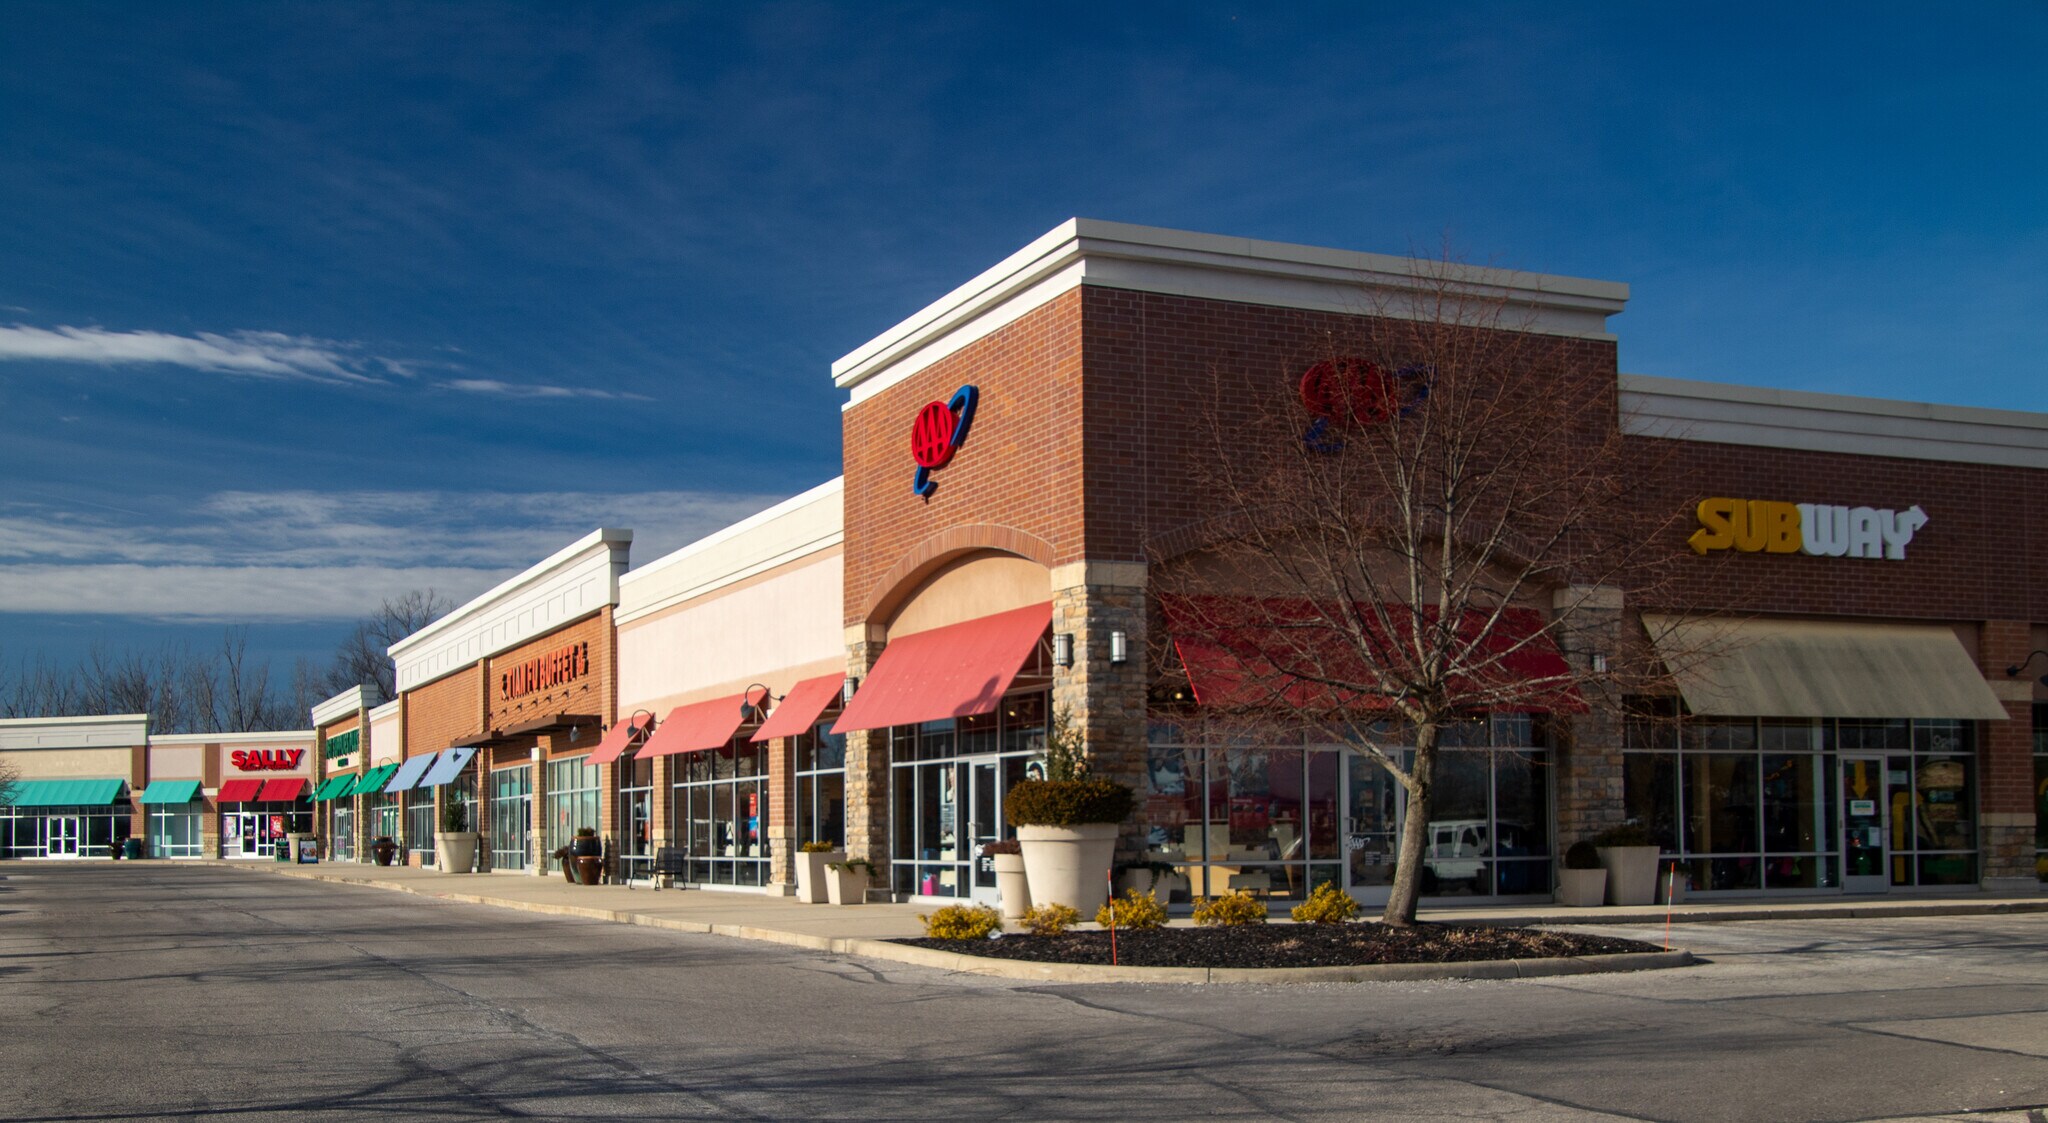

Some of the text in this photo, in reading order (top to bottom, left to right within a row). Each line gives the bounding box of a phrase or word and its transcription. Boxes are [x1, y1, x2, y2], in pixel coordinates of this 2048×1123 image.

[912, 402, 952, 467] AAA
[1688, 498, 1929, 560] SUBWAY
[231, 749, 304, 767] SALLY
